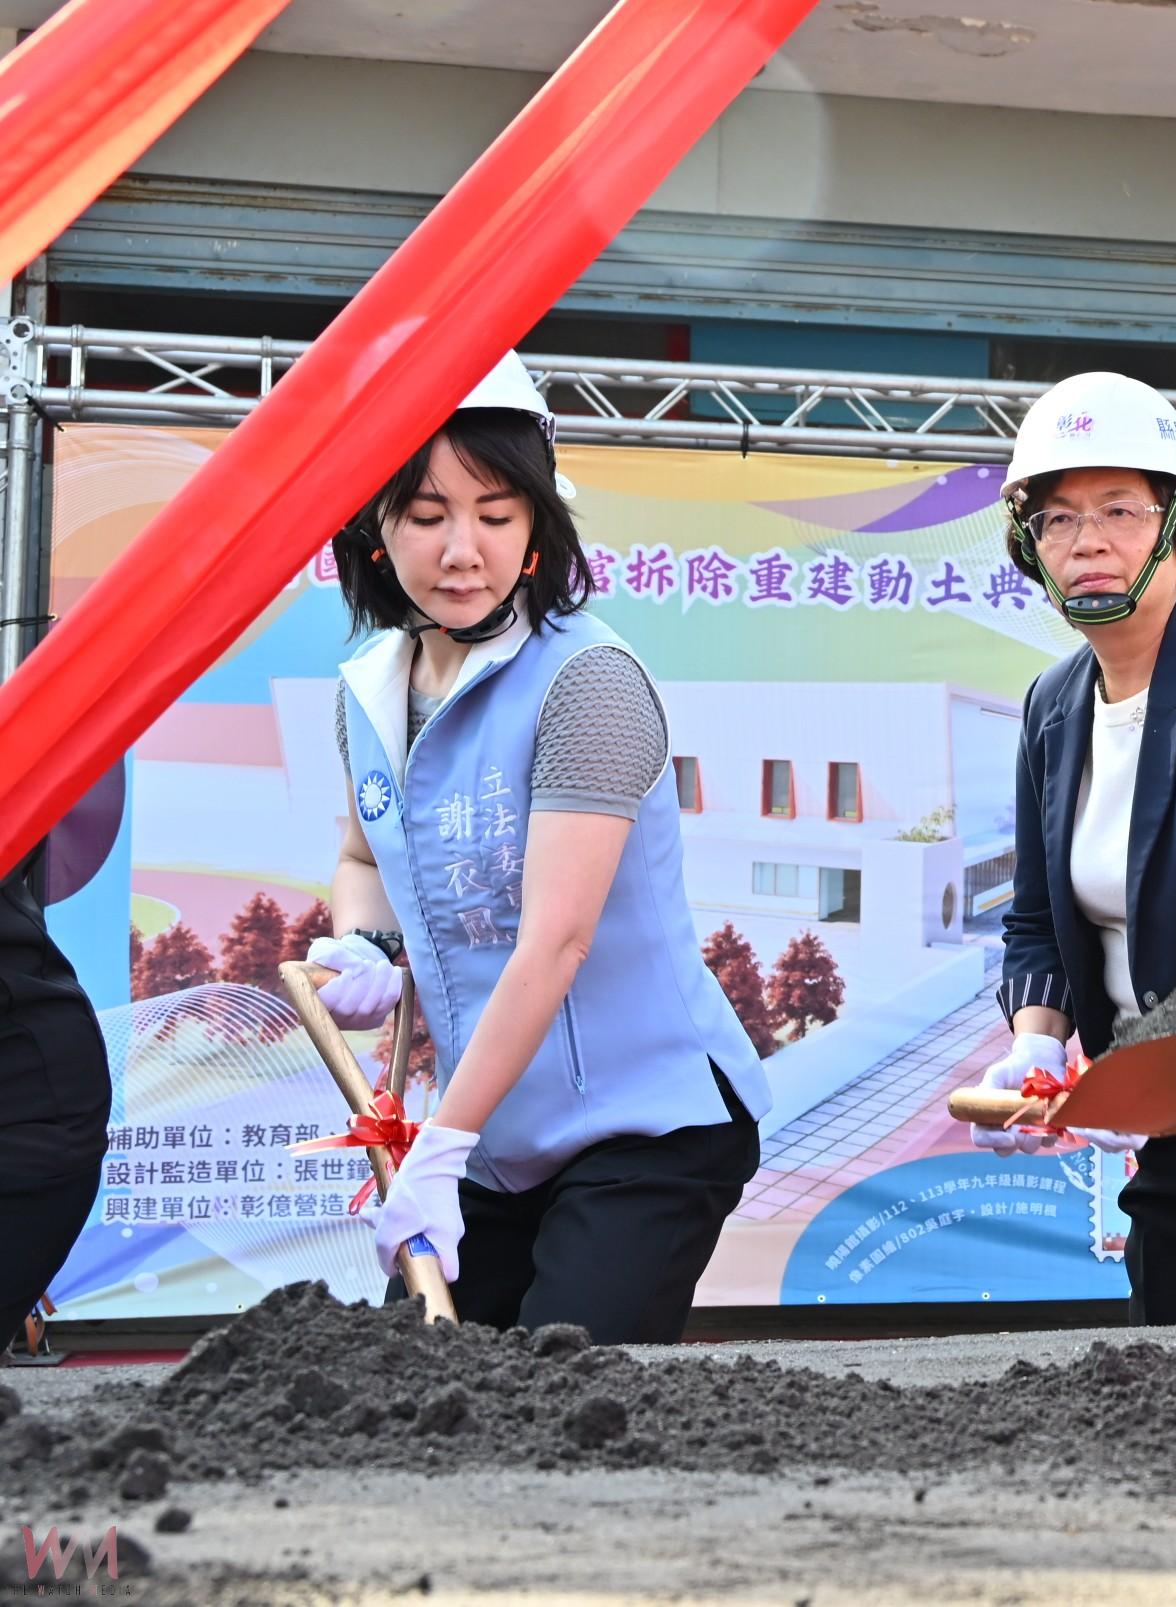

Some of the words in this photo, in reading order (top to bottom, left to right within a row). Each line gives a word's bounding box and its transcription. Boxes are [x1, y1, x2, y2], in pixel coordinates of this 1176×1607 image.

[568, 549, 1048, 611] 館拆除重建動土典
[105, 1193, 382, 1221] 興建單位：彰億營造
